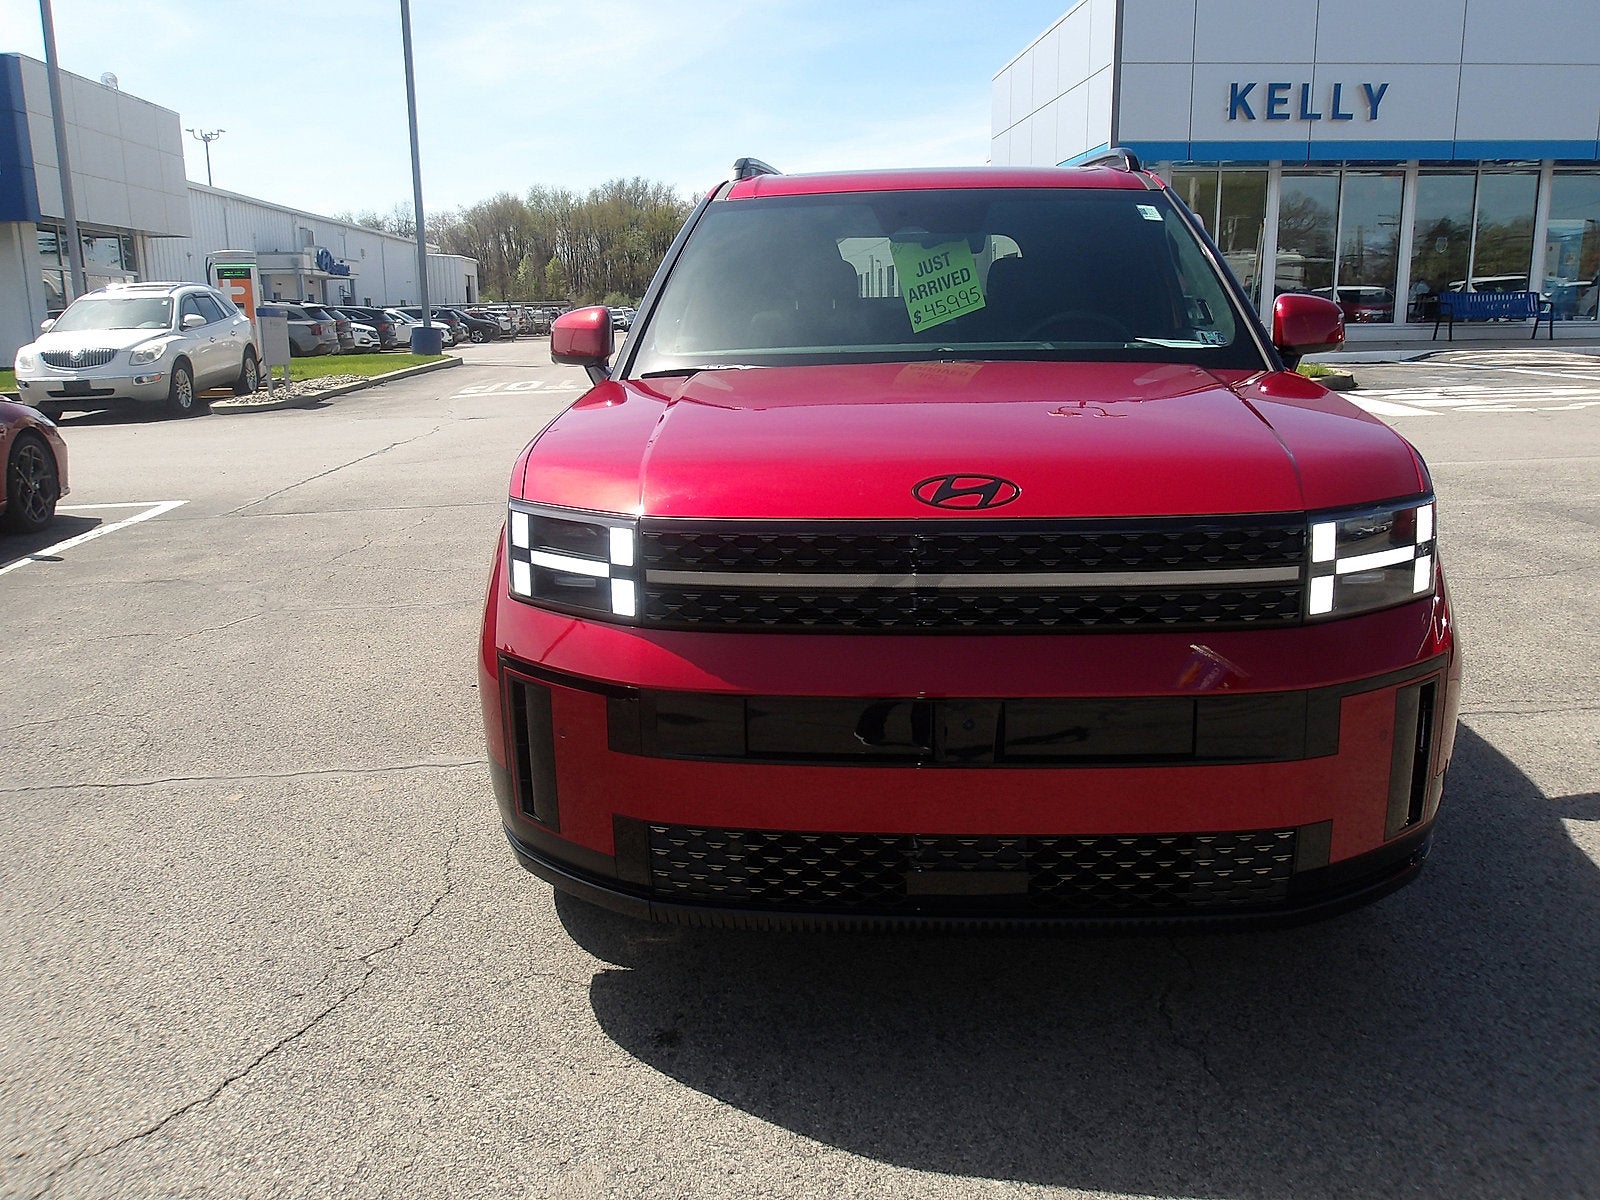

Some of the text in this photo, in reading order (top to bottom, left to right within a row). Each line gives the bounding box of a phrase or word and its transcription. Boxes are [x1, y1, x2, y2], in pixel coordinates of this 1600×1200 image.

[1228, 82, 1390, 121] KELLY
[916, 252, 950, 278] JUST
[909, 267, 971, 304] ARRIVED
